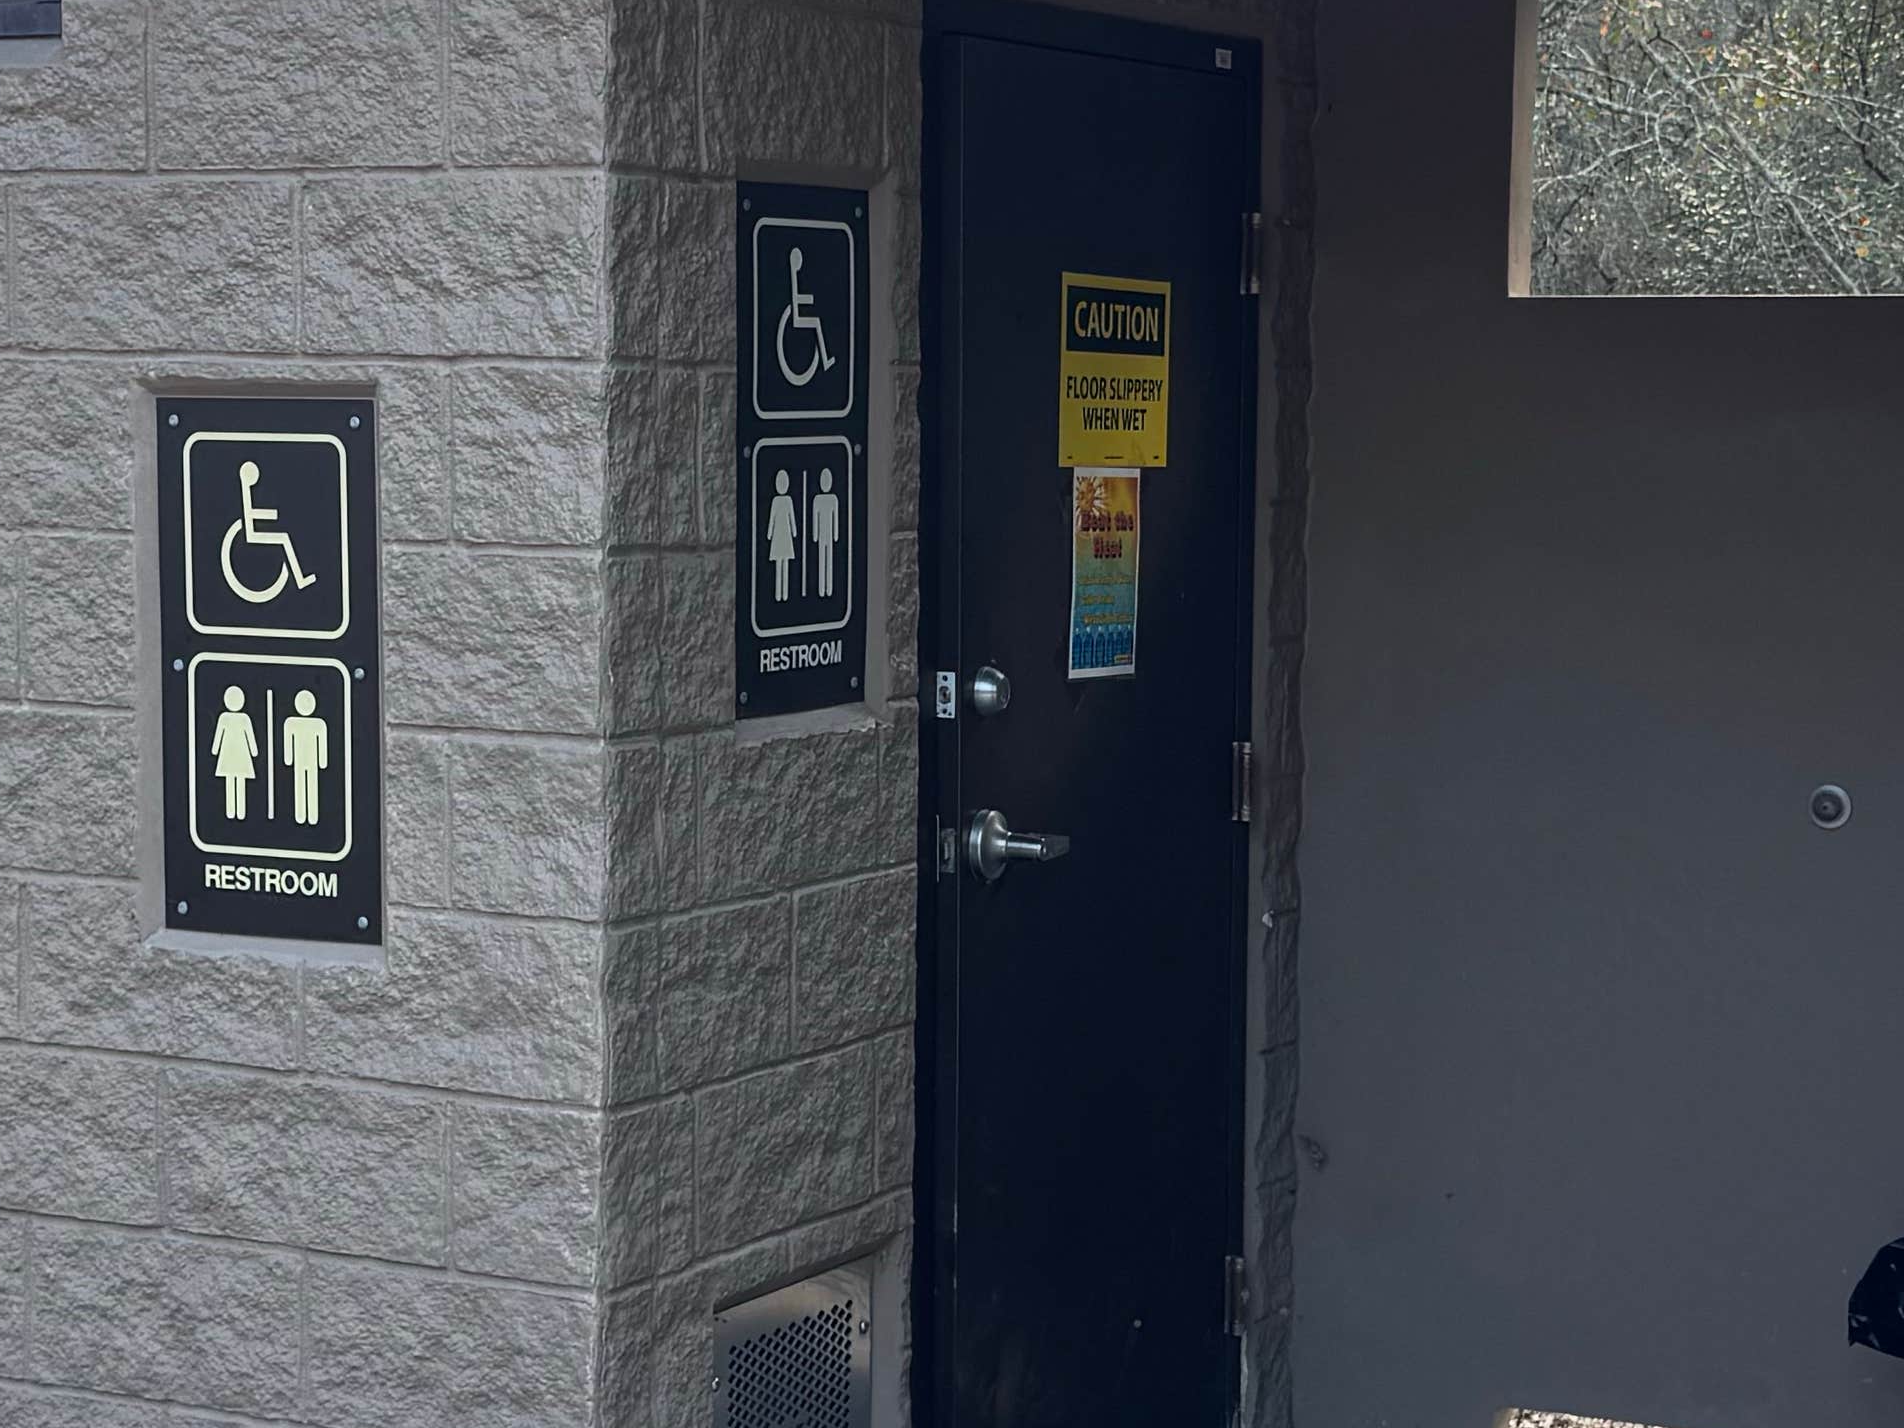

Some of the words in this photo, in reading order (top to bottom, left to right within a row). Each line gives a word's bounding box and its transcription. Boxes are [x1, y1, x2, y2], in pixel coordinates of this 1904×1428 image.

[1074, 300, 1159, 342] CAUTION
[1066, 375, 1107, 401] FLOOR
[1109, 377, 1163, 402] SLIPPERY
[1082, 406, 1119, 431] WHEN
[1121, 408, 1147, 432] WET
[760, 639, 842, 673] RESTROOM
[204, 863, 339, 898] RESTROOM
